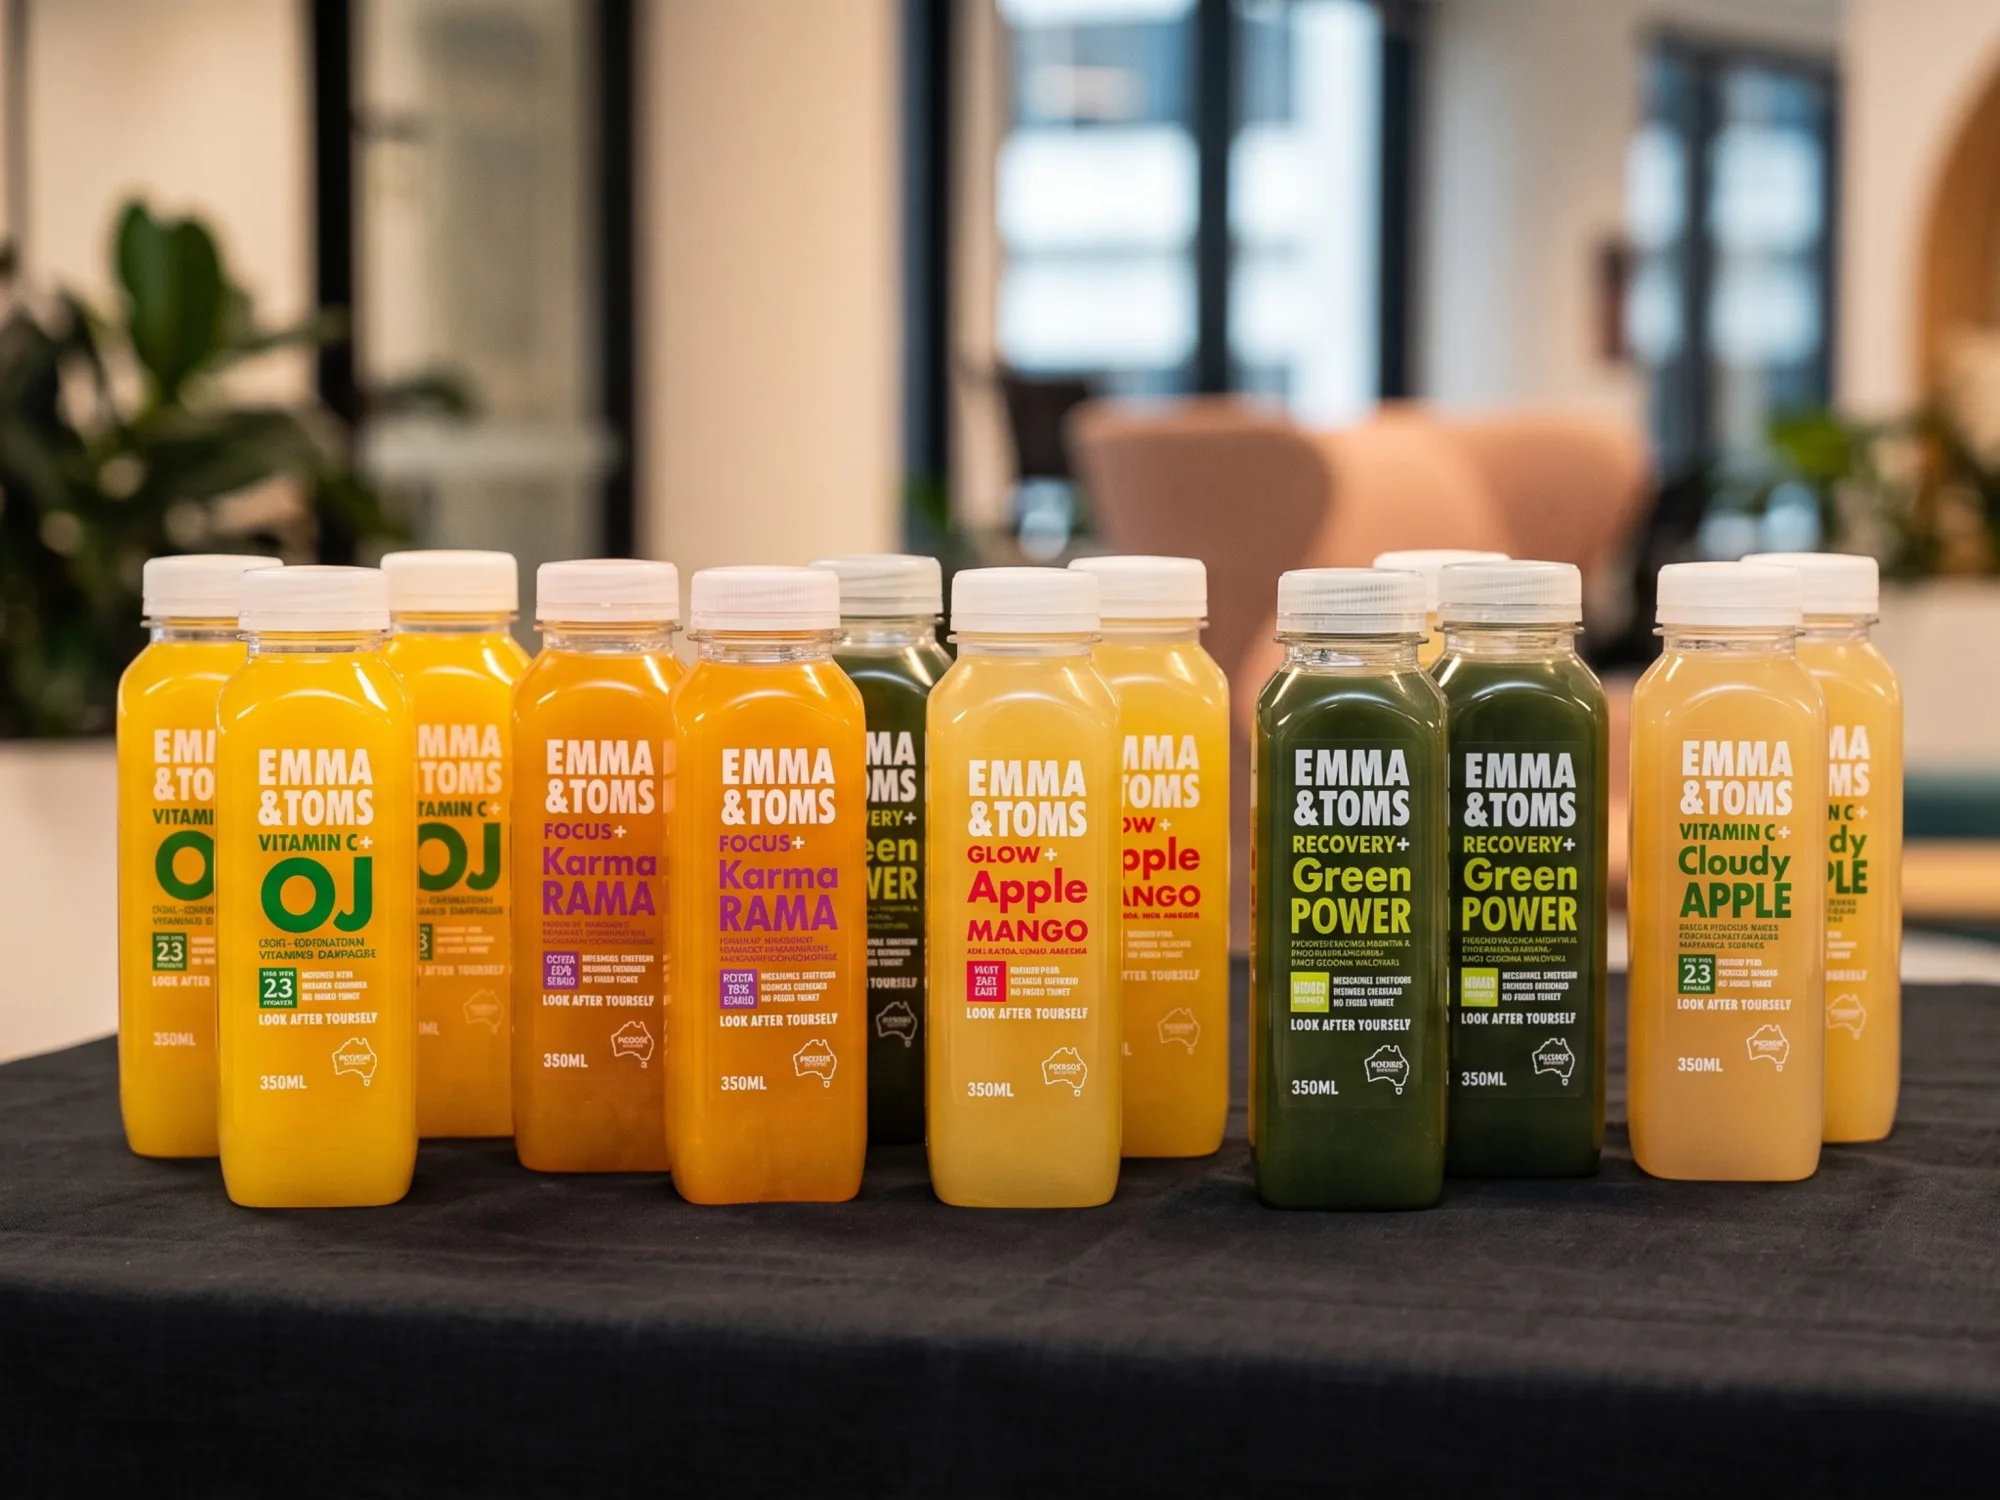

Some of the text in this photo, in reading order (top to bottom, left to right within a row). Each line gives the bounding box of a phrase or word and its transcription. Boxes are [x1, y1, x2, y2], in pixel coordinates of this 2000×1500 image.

[417, 724, 503, 758] MMA
[546, 738, 655, 776] EMMA
[866, 731, 917, 766] MA
[1682, 740, 1794, 777] EMMA
[258, 748, 373, 786] EMMA
[415, 761, 503, 795] TOMS
[721, 747, 836, 785] EMMA
[968, 759, 1088, 797] EMMA
[1294, 748, 1411, 787] EMMA
[1465, 752, 1577, 789] EMMA
[153, 767, 215, 802] &TO
[545, 777, 656, 815] &TOMS
[1680, 779, 1794, 816] &TOMS
[152, 808, 214, 826] VITAMI
[258, 789, 374, 827] &TOMS
[417, 801, 473, 817] TAMIN
[721, 788, 837, 826] &TOMS
[967, 800, 1088, 838] &TOMS
[1293, 789, 1411, 827] &TOMS
[1464, 791, 1577, 828] &TOMS
[258, 833, 341, 852] VITAMIN
[1679, 823, 1760, 841] VITAMIN
[155, 830, 215, 901] O
[418, 822, 502, 892] OJ
[543, 846, 657, 877] Karma
[719, 859, 839, 890] Karma
[1123, 836, 1201, 881] pple
[1292, 856, 1412, 893] Green
[1463, 857, 1577, 892] Green
[1678, 844, 1792, 882] Cloudy
[260, 856, 373, 934] OJ
[543, 881, 657, 917] RAMA
[966, 867, 1088, 914] Apple
[1679, 882, 1792, 919] APPLE
[719, 894, 839, 932] RAMA
[966, 918, 1089, 943] MANGO
[1291, 896, 1412, 935] POWER
[1462, 896, 1578, 932] POWER
[156, 941, 184, 962] 23
[263, 977, 293, 998] 23
[1682, 964, 1712, 984] 23
[542, 995, 570, 1007] LOOK
[572, 995, 604, 1007] AFTER
[966, 1007, 995, 1019] LOOK
[998, 1007, 1032, 1019] AFTER
[1461, 1012, 1489, 1025] LOOK
[1491, 1012, 1524, 1025] AFTER
[1677, 998, 1705, 1011] LOOK
[258, 1013, 288, 1026] LOOK
[290, 1013, 324, 1025] AFTER
[719, 1015, 749, 1028] LOOK
[751, 1014, 784, 1027] AFTER
[1290, 1018, 1320, 1031] LOOK
[1322, 1018, 1356, 1031] AFTER
[543, 1053, 589, 1069] 350ML
[1677, 1057, 1724, 1073] 350ML
[259, 1074, 308, 1090] 350ML
[720, 1075, 768, 1091] 350ML
[967, 1081, 1015, 1097] 350ML
[1291, 1079, 1340, 1096] 350ML
[1461, 1071, 1508, 1087] 350ML
